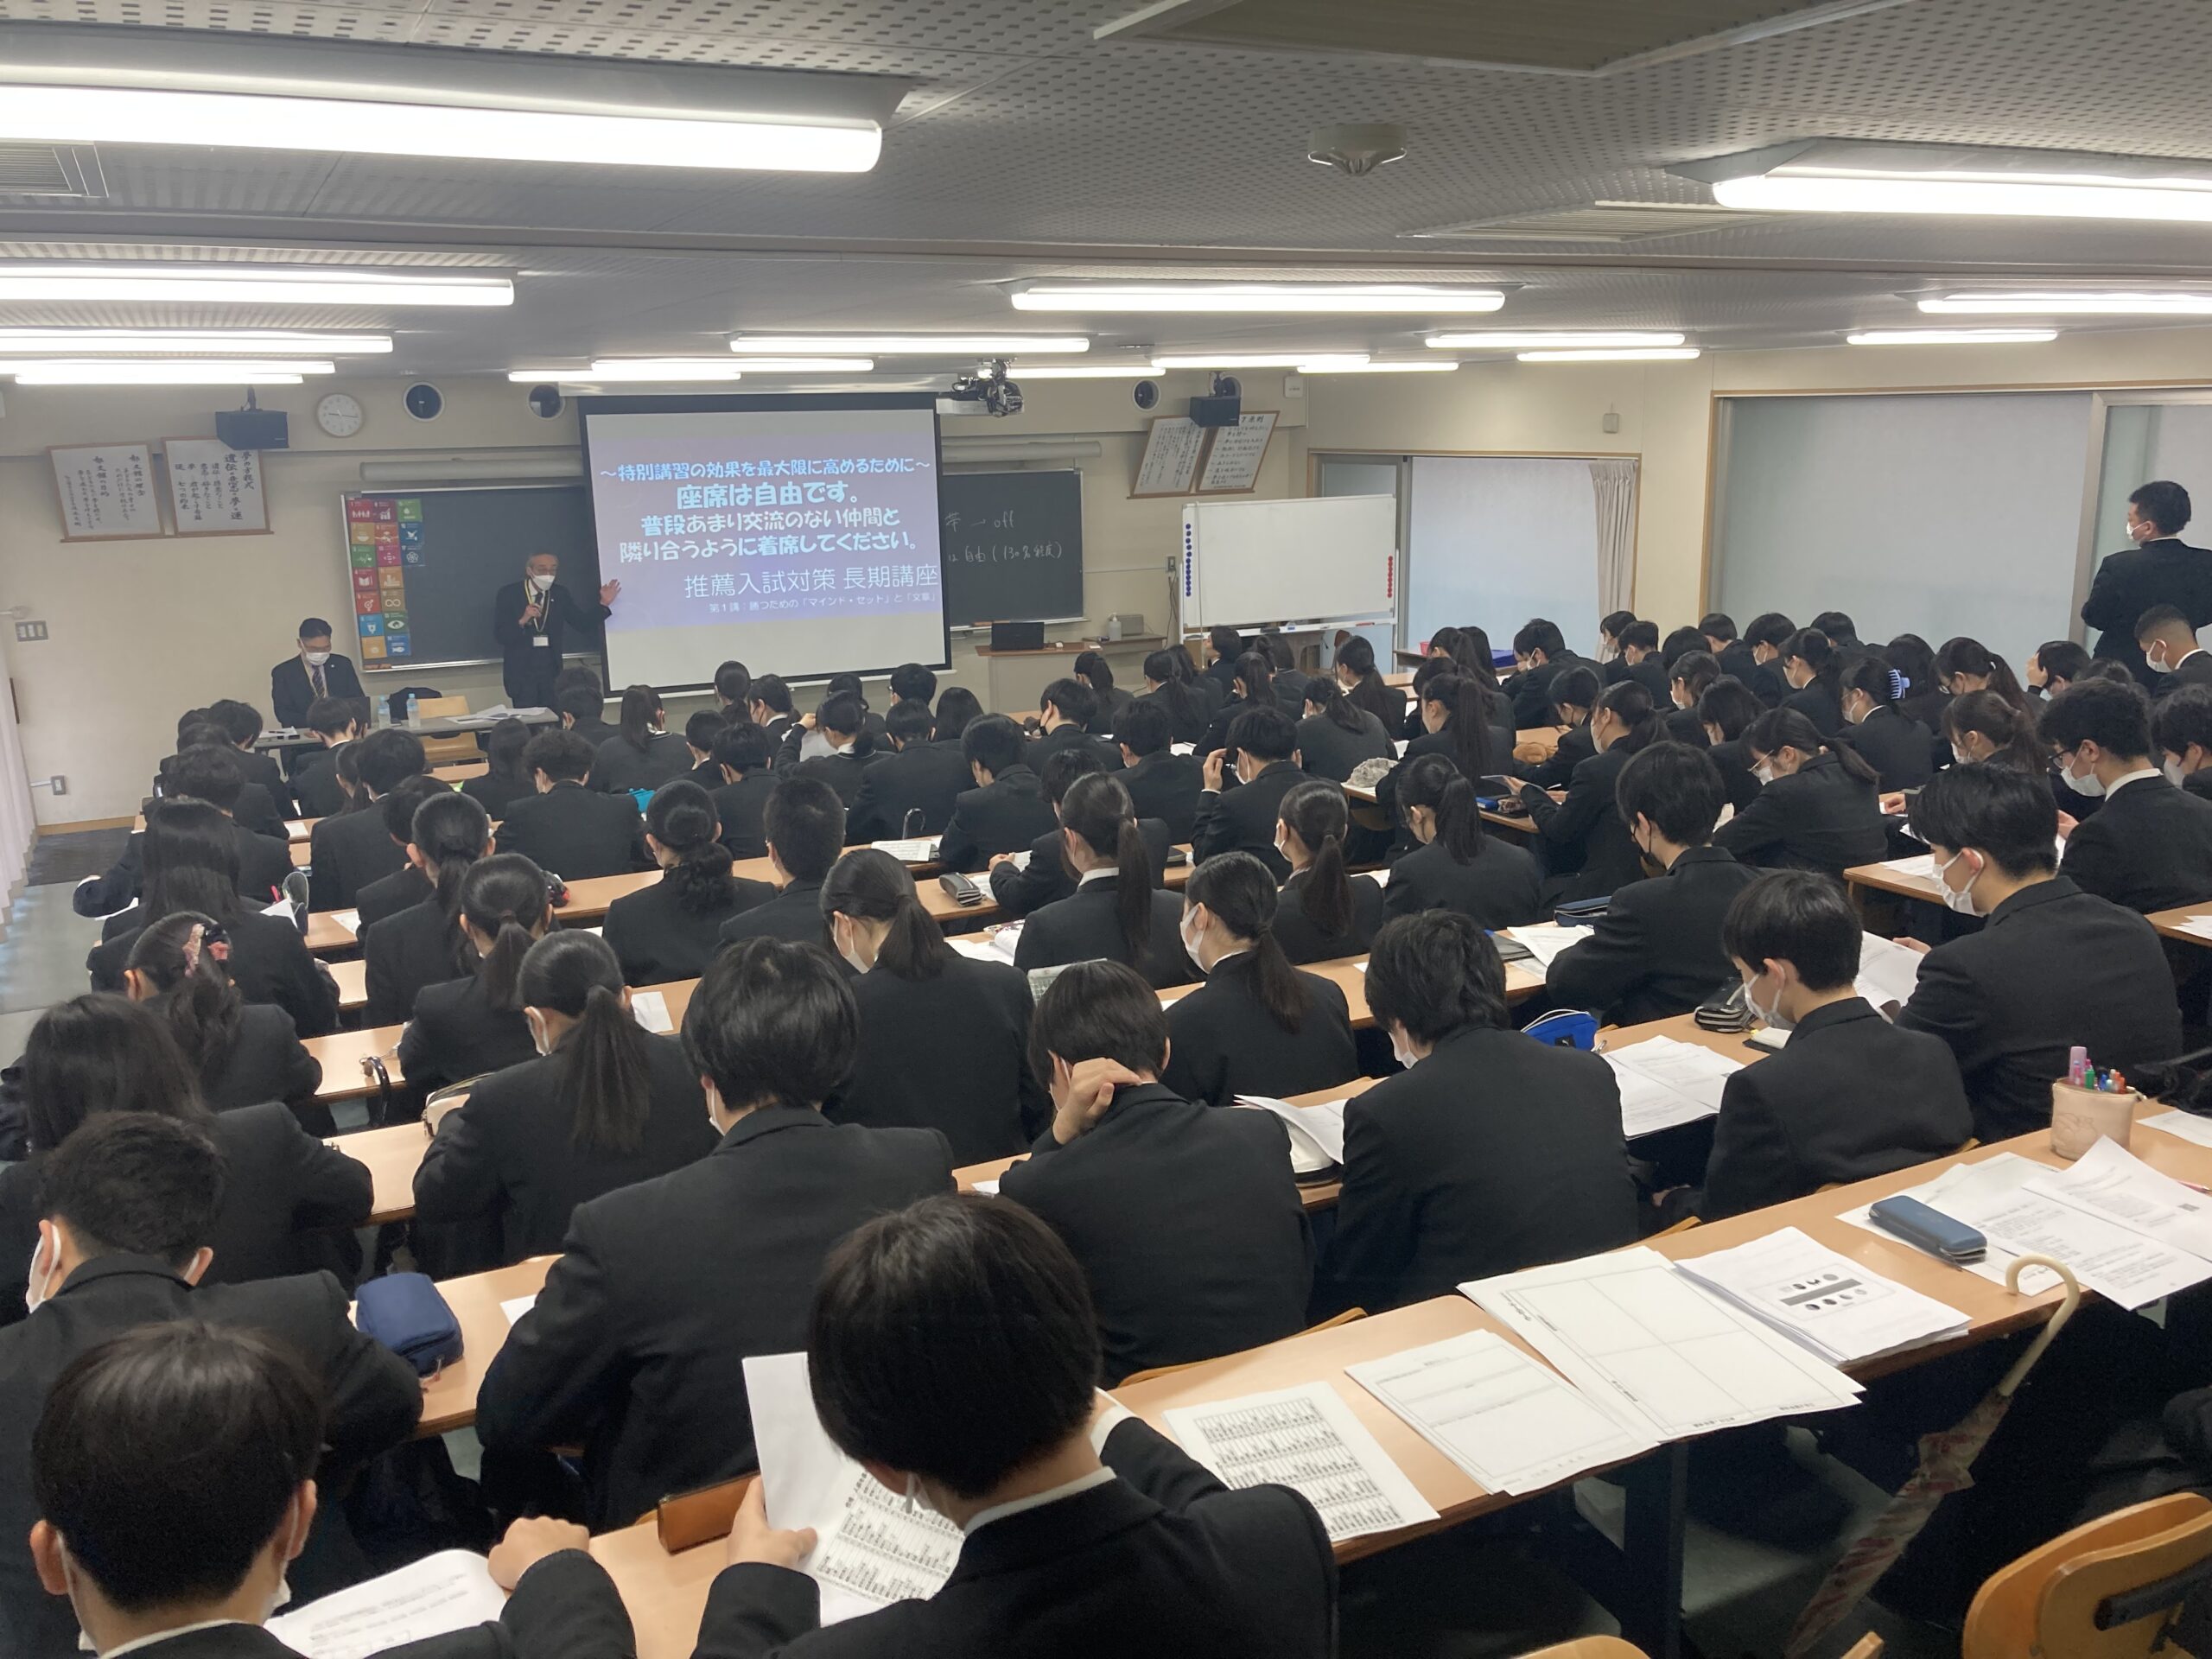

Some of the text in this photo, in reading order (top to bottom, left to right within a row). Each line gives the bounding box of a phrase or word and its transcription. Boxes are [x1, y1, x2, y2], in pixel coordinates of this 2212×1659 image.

[677, 480, 858, 510] 座席は自由です。
[641, 507, 901, 537] 普段あまり交流のない仲間と
[620, 531, 917, 563] 隣り合うように着席してください。
[684, 563, 939, 598] 推薦入試対策 長期講座
